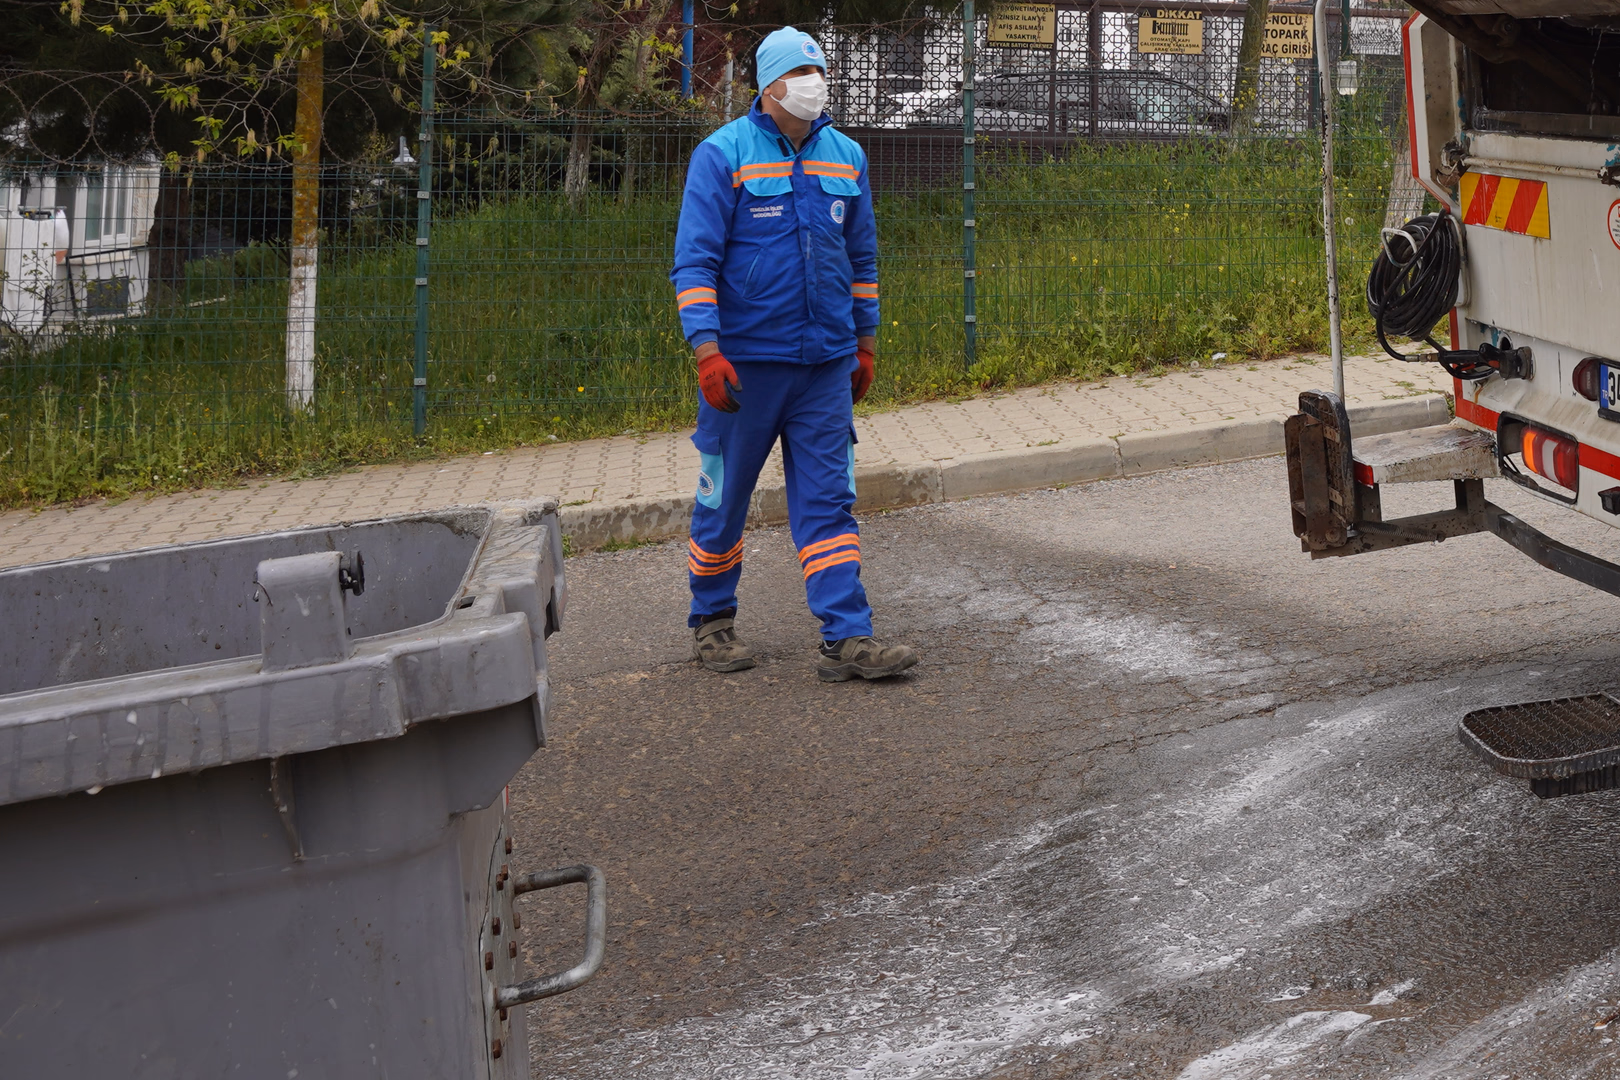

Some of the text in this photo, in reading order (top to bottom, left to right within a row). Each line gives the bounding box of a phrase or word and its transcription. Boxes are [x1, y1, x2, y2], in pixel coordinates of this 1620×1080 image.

[1156, 9, 1202, 19] DİKKAT
[1264, 14, 1303, 26] -NOLU
[1264, 28, 1309, 40] TOPARK
[1260, 41, 1312, 57] RAÇ GİRİŞİ
[1602, 389, 1609, 400] TR
